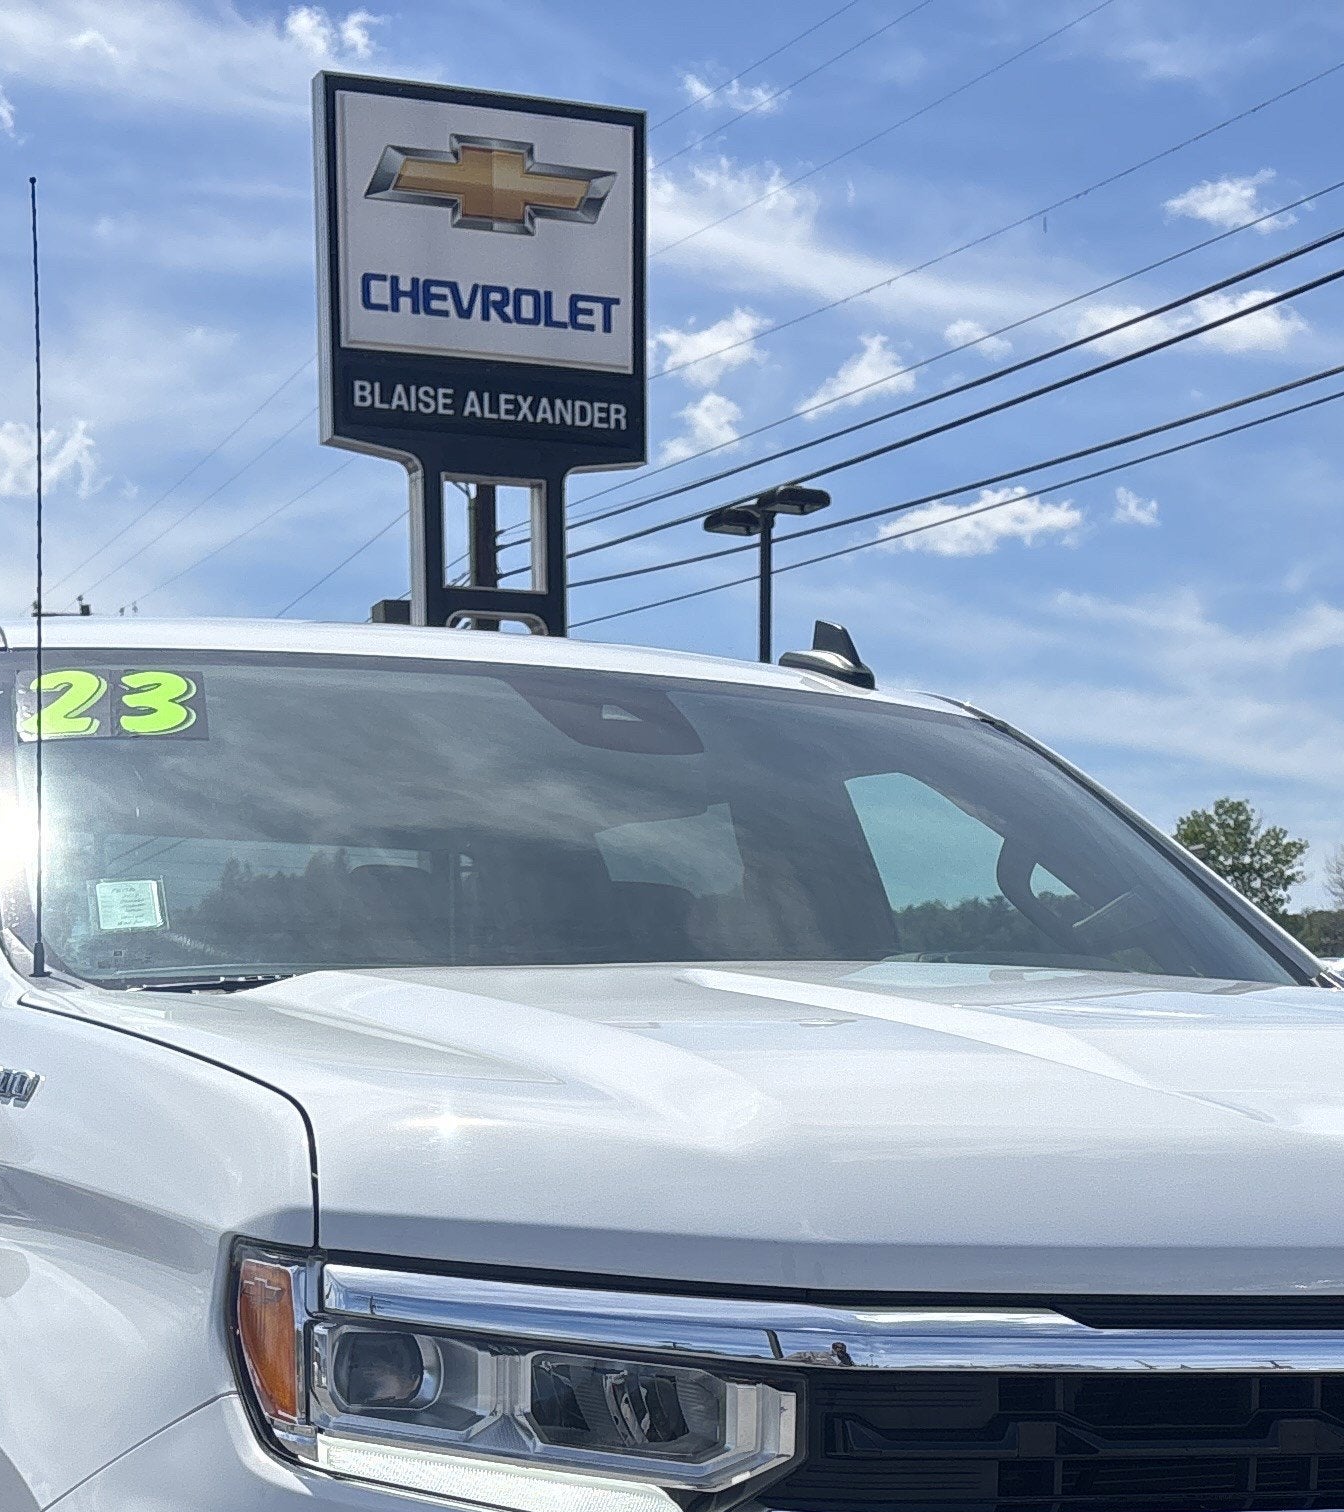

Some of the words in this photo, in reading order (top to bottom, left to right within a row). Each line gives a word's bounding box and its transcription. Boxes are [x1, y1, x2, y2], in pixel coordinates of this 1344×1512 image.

[361, 272, 620, 333] CHEVROLET
[353, 379, 454, 416] BLAISE
[463, 391, 627, 431] ALEXANDER
[21, 670, 197, 736] 23
